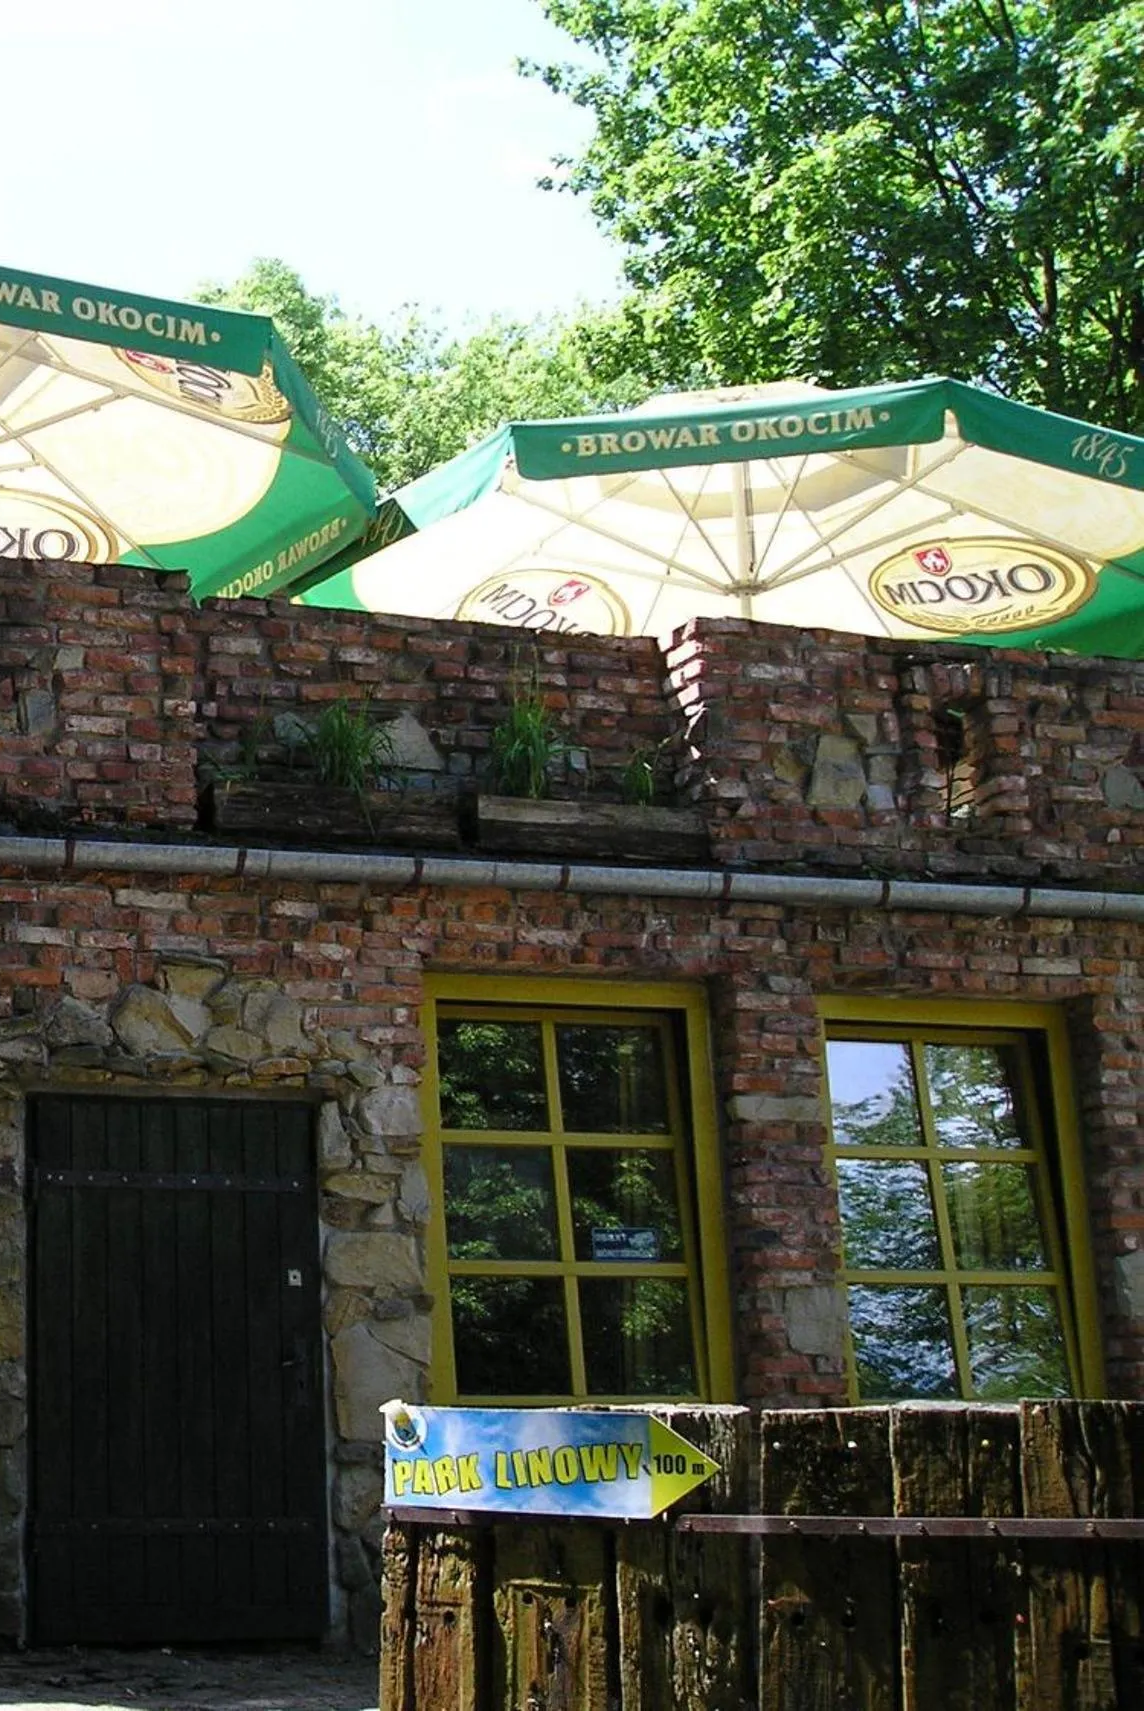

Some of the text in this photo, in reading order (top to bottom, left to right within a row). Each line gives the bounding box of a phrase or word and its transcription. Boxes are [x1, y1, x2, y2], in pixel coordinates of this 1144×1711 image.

[72, 296, 207, 347] OKOCIM
[576, 407, 876, 458] BROWAR OKOCIM
[1070, 433, 1137, 479] 1845
[393, 1441, 705, 1497] PARK LINOWY 100 m
